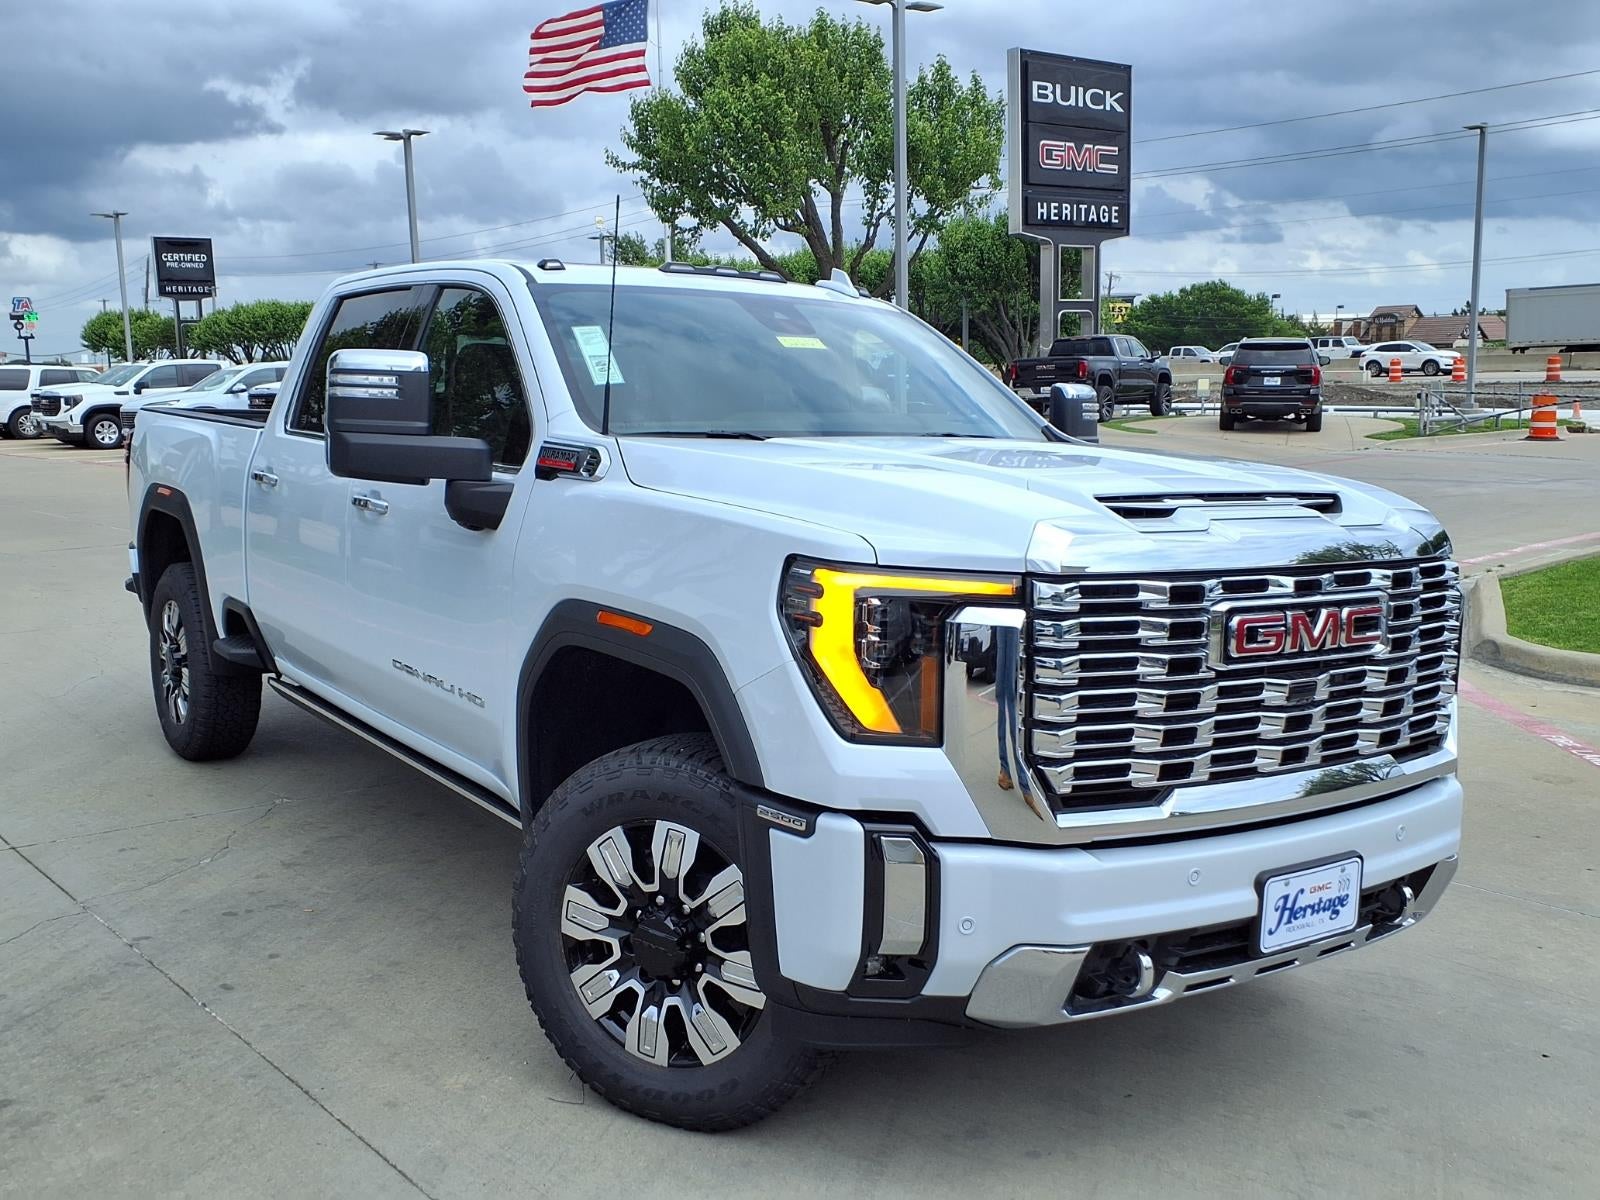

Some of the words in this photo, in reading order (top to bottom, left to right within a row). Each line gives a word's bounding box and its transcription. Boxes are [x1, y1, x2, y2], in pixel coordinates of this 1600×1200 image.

[1031, 80, 1125, 113] BUICK
[1039, 139, 1119, 175] GMC
[1036, 201, 1120, 224] HERITAGE
[161, 252, 208, 262] CERTIFIED
[165, 261, 205, 270] PRE-OWNED
[165, 284, 211, 294] HERITAGE
[13, 298, 33, 312] TA
[542, 447, 577, 463] DURAMAX
[1228, 604, 1384, 658] GMC
[391, 658, 456, 695] DENALI
[457, 687, 486, 709] HD
[758, 808, 803, 827] 2500
[1309, 881, 1333, 895] GMC
[1268, 887, 1349, 936] Heritage
